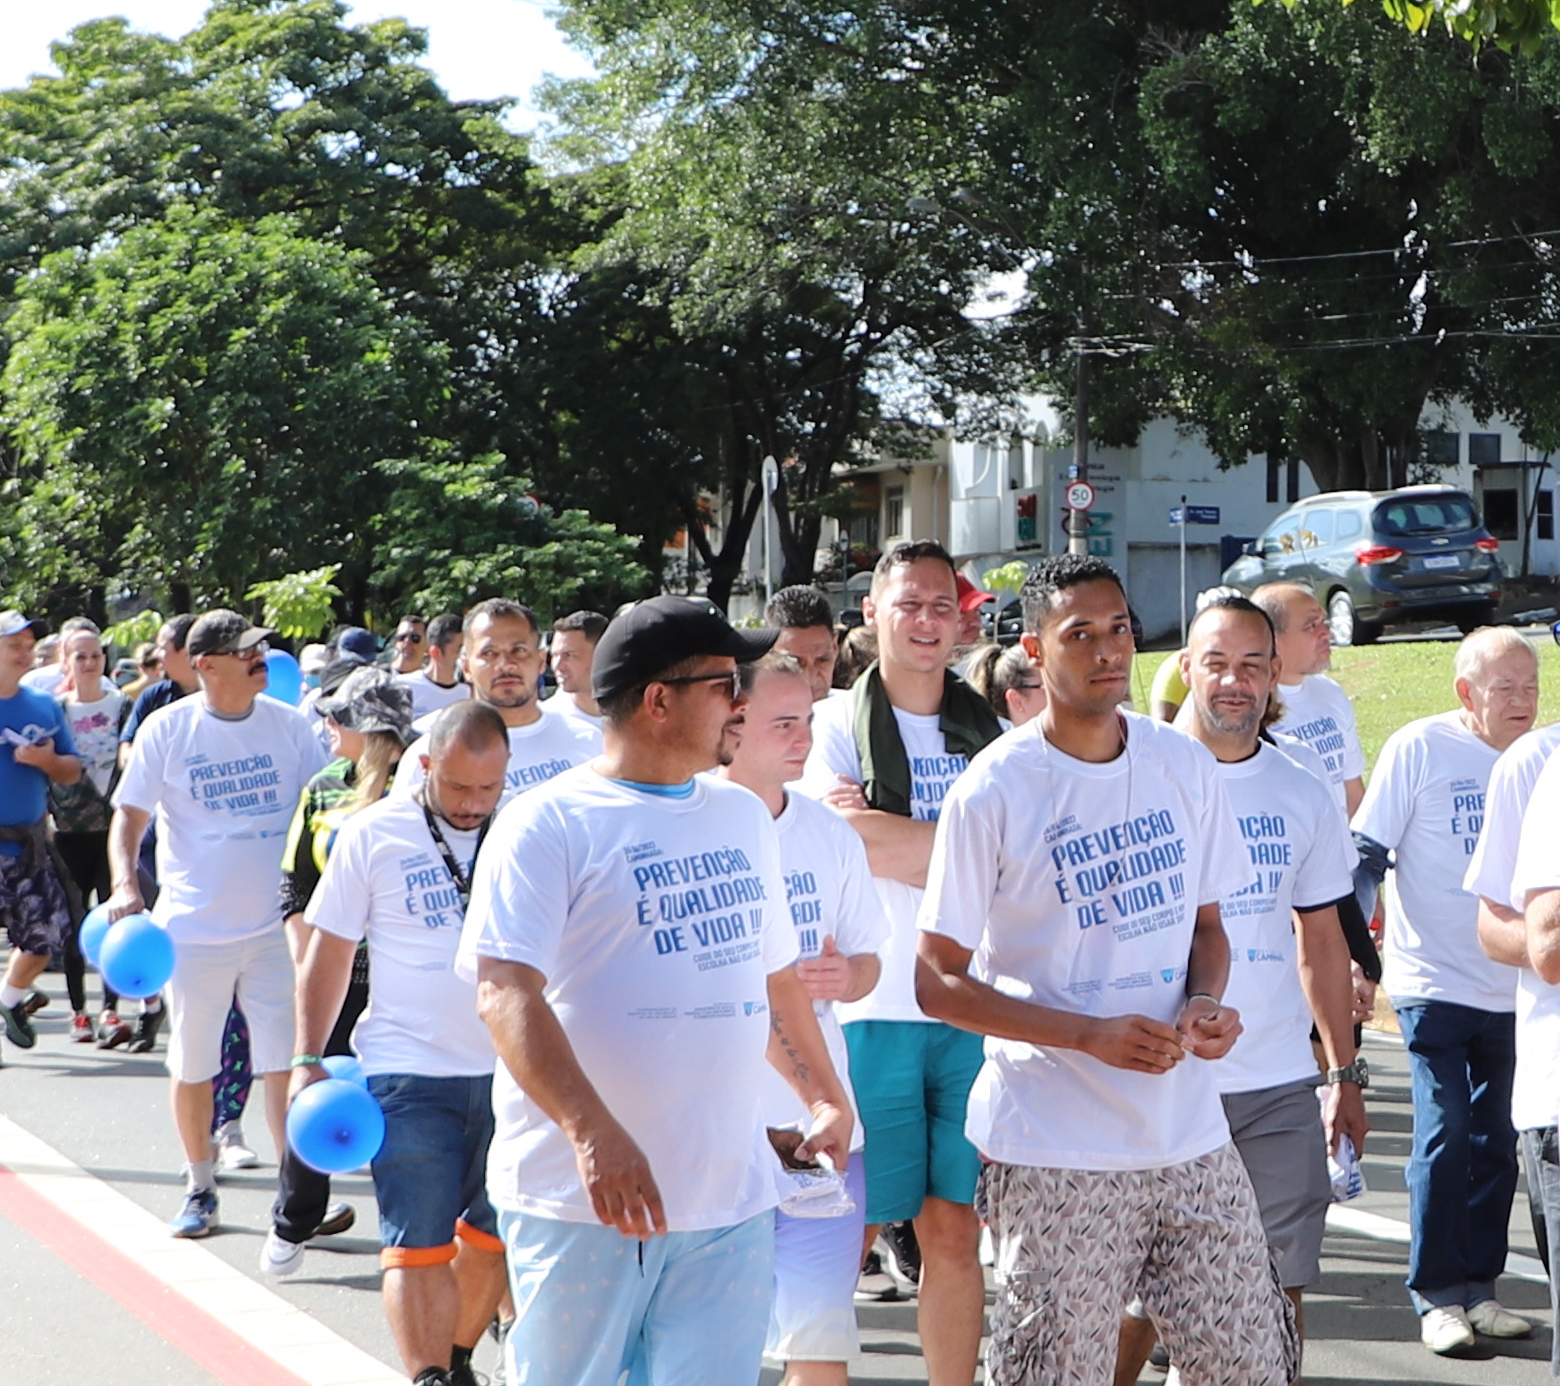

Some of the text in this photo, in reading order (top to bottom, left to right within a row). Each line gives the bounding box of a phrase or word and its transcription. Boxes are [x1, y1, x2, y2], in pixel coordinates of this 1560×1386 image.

[1071, 488, 1090, 502] 50
[190, 754, 273, 783] PREVENÇÃO
[203, 770, 281, 799] QUALIDADE
[225, 792, 260, 810] VIDA
[1051, 809, 1175, 871] PREVENÇÃO
[633, 845, 752, 892] PREVENÇÃO
[1055, 873, 1072, 904] É
[1075, 838, 1187, 897] QUALIDADE
[405, 894, 418, 915] É
[636, 894, 652, 926] É
[659, 876, 767, 923] QUALIDADE
[1077, 872, 1185, 930] DE VIDA !!!
[654, 908, 762, 955] DE VIDA !!!
